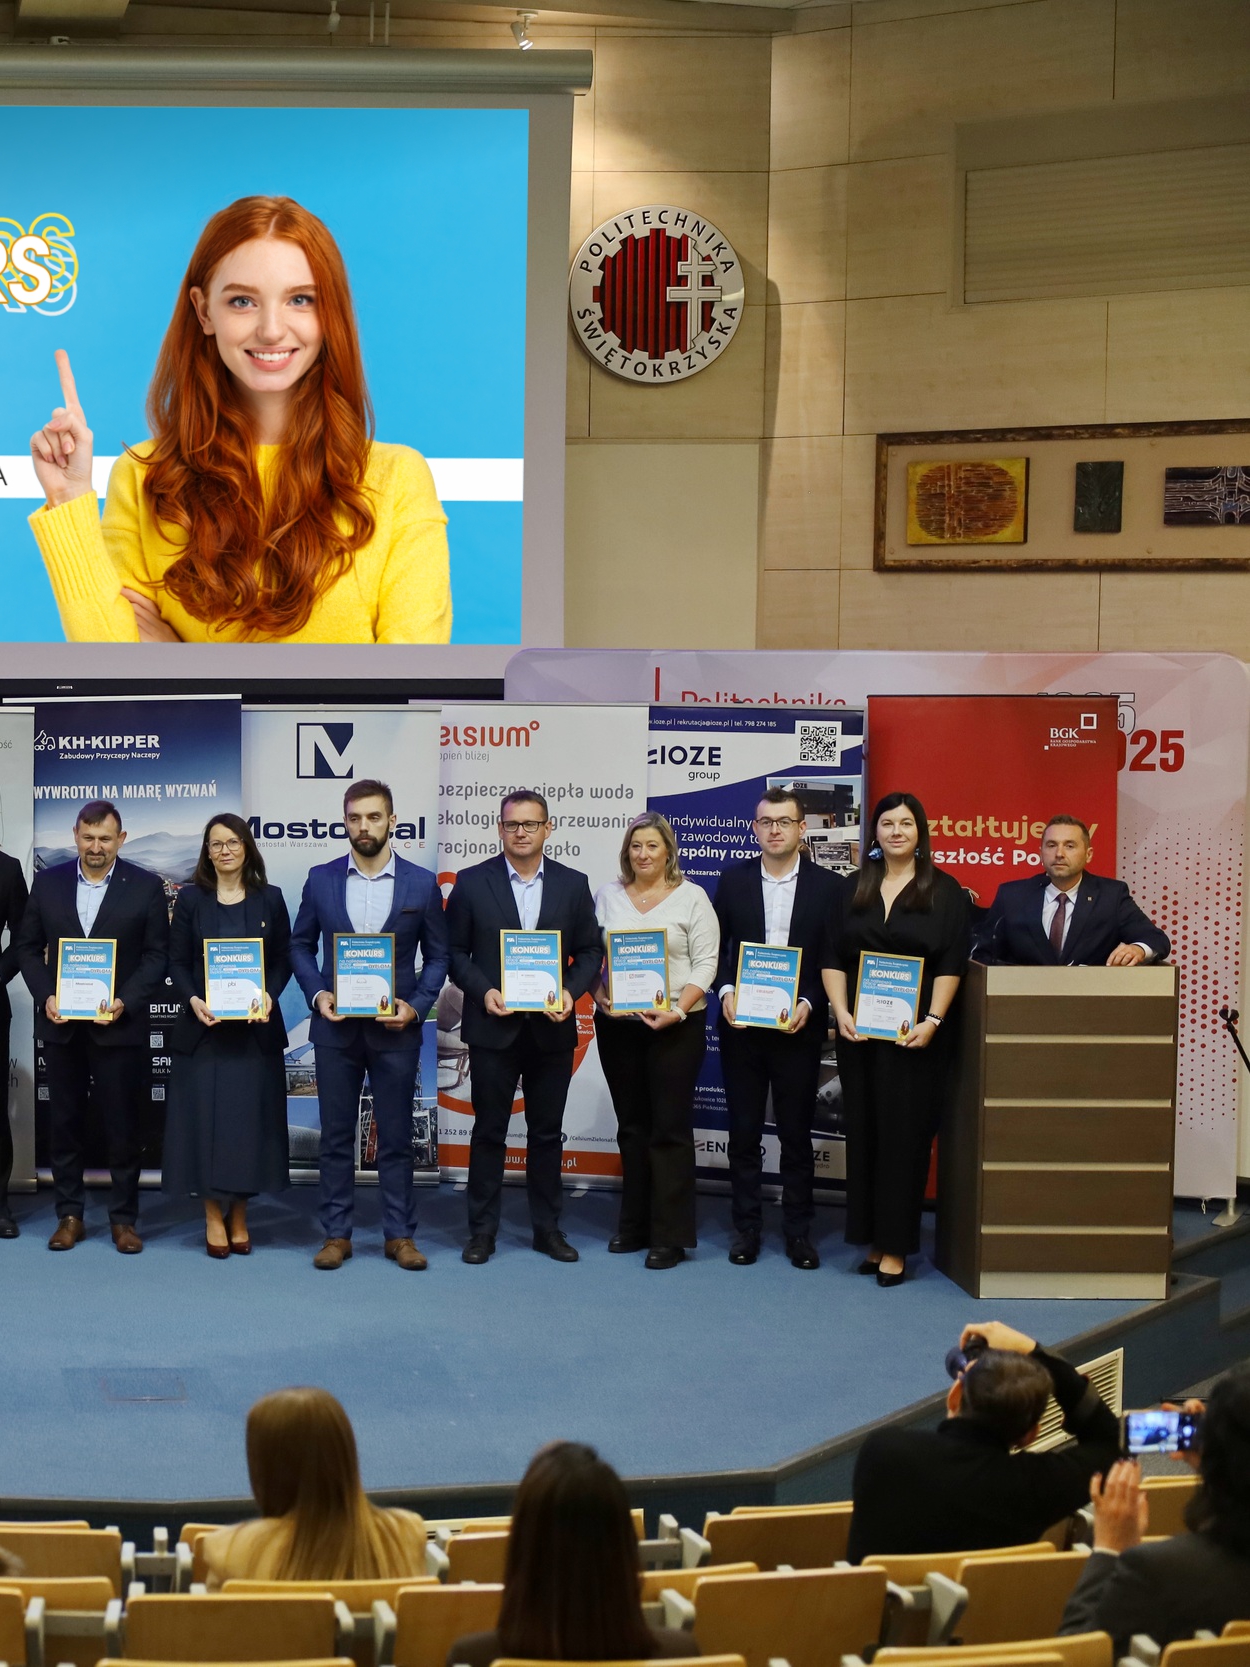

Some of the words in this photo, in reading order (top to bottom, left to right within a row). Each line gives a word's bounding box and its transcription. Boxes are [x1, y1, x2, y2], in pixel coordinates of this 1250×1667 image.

[579, 210, 735, 274] POLITECHNIKA
[577, 306, 737, 378] ŚWIĘTOKRZYSKA
[440, 724, 530, 747] elsium
[1050, 727, 1079, 738] BGK
[58, 735, 160, 750] KH-KIPPER
[59, 752, 95, 760] Zabudowy
[96, 752, 130, 760] Przyczepy
[688, 770, 720, 782] group
[34, 785, 98, 799] WYWROTKI
[102, 785, 117, 799] NA
[123, 784, 161, 801] MIARĘ
[165, 780, 217, 798] WYZWAŃ
[590, 784, 634, 799] woda
[681, 832, 746, 845] zawodowy
[730, 850, 763, 859] rozw
[344, 948, 385, 958] KONKURS
[511, 945, 550, 954] KONKURS
[618, 944, 658, 954] KONKURS
[69, 954, 106, 963] KONKURS
[214, 954, 253, 963] KONKURS
[748, 960, 790, 971] KONKURS
[869, 970, 911, 982] KONKURS
